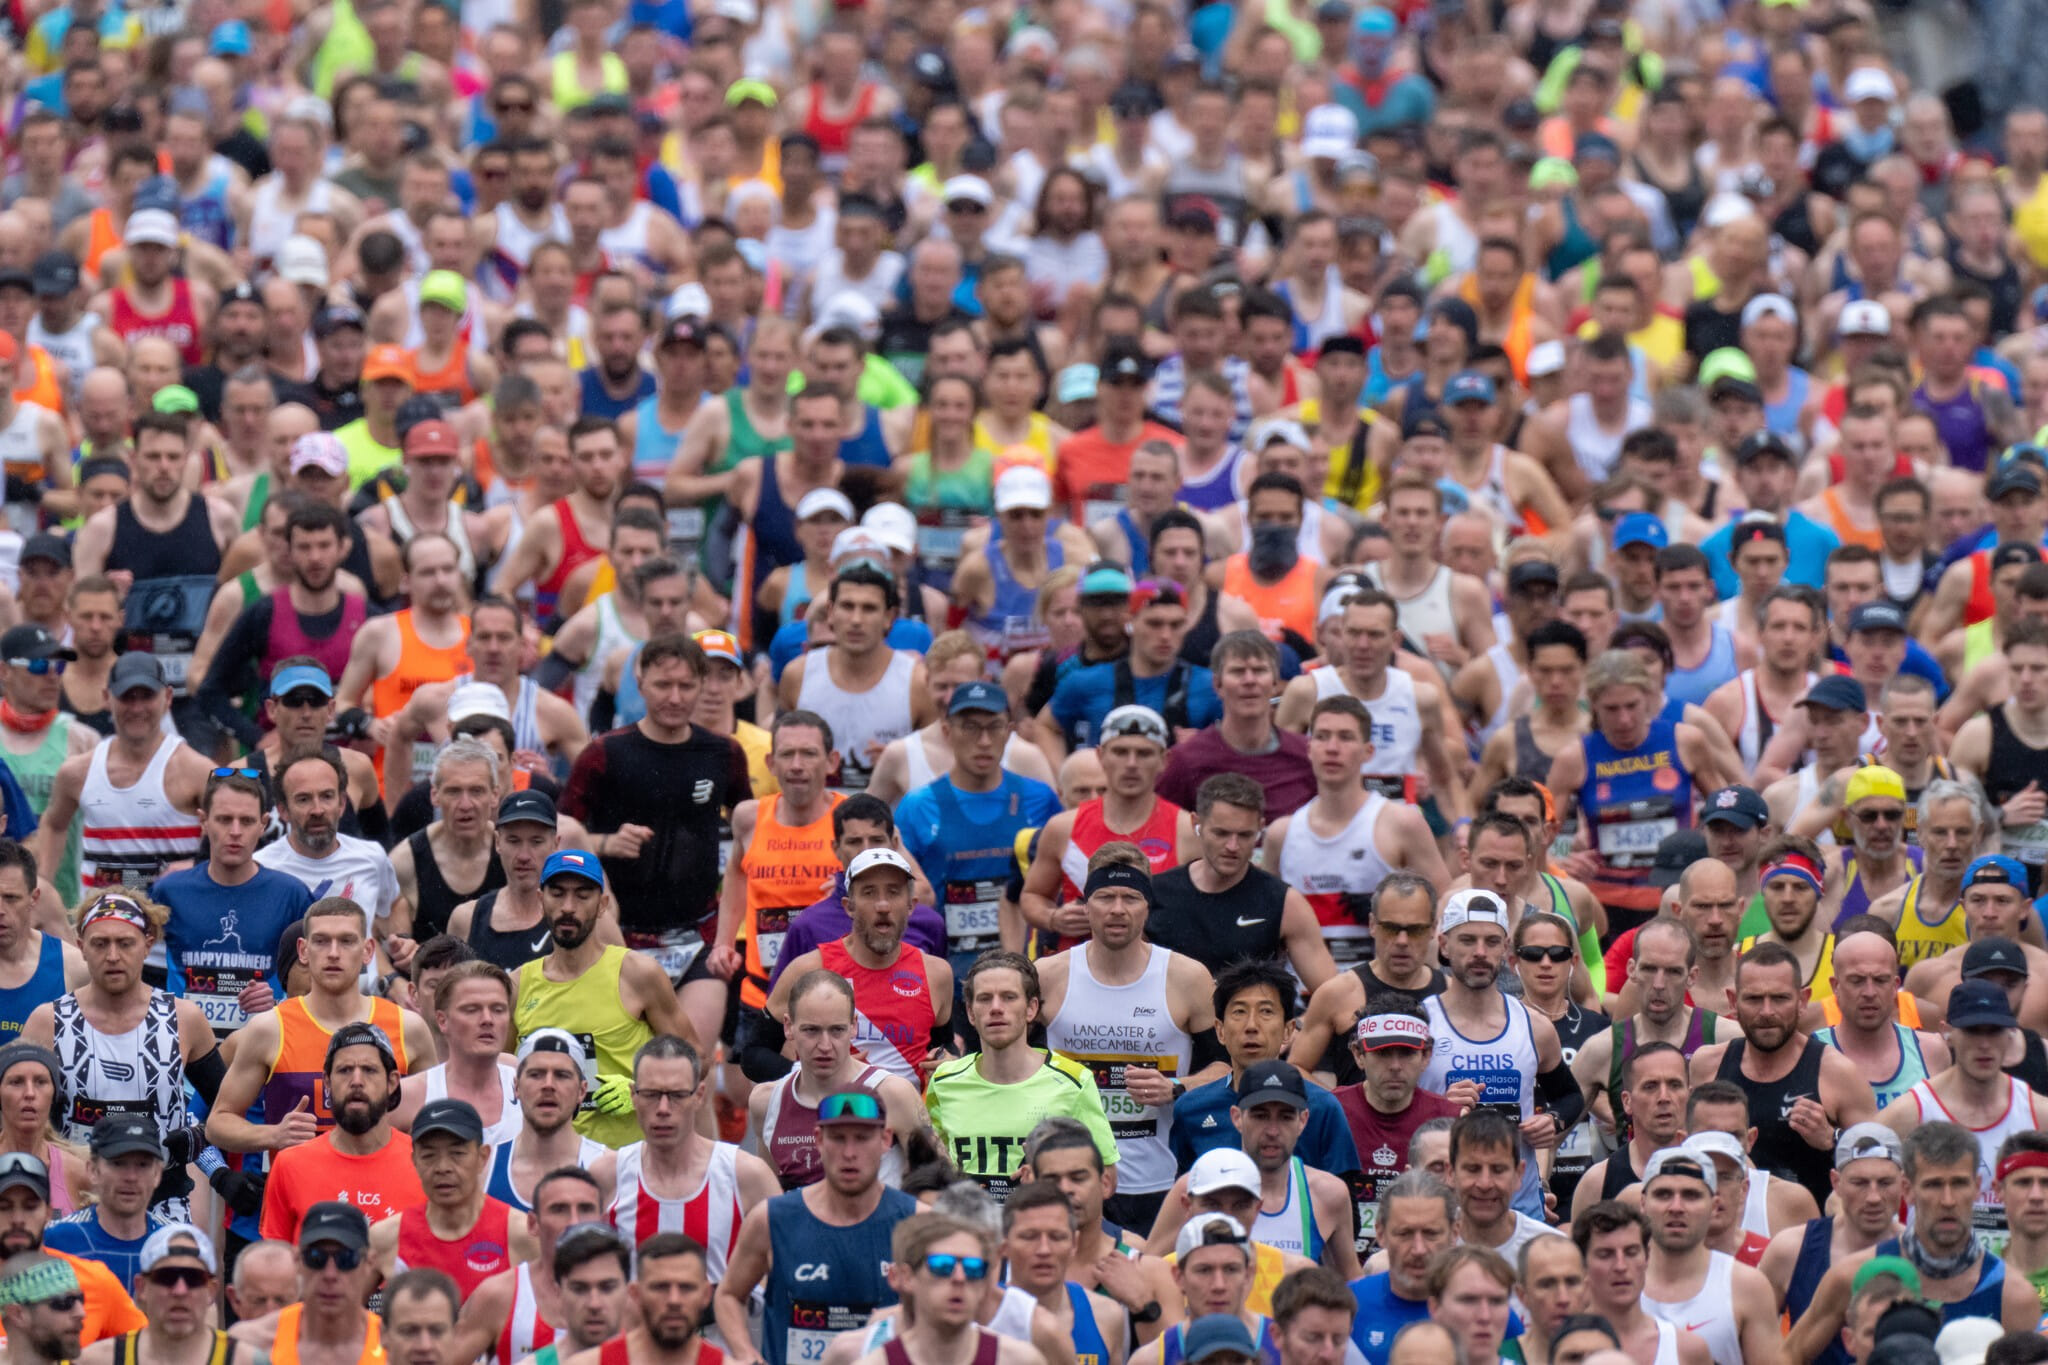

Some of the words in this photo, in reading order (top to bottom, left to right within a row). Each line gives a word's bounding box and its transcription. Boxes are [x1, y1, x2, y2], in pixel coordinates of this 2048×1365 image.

[767, 839, 823, 851] Richard
[182, 951, 272, 970] #HAPPYRUNNERS
[1073, 1024, 1144, 1038] LANCASTER
[1147, 1027, 1157, 1039] &
[1064, 1038, 1140, 1050] MORECAMBE
[1452, 1054, 1514, 1071] CHRIS
[1479, 1075, 1519, 1084] Rollason
[1486, 1086, 1518, 1096] Charity
[357, 1191, 381, 1205] tcs
[794, 1263, 829, 1282] CA
